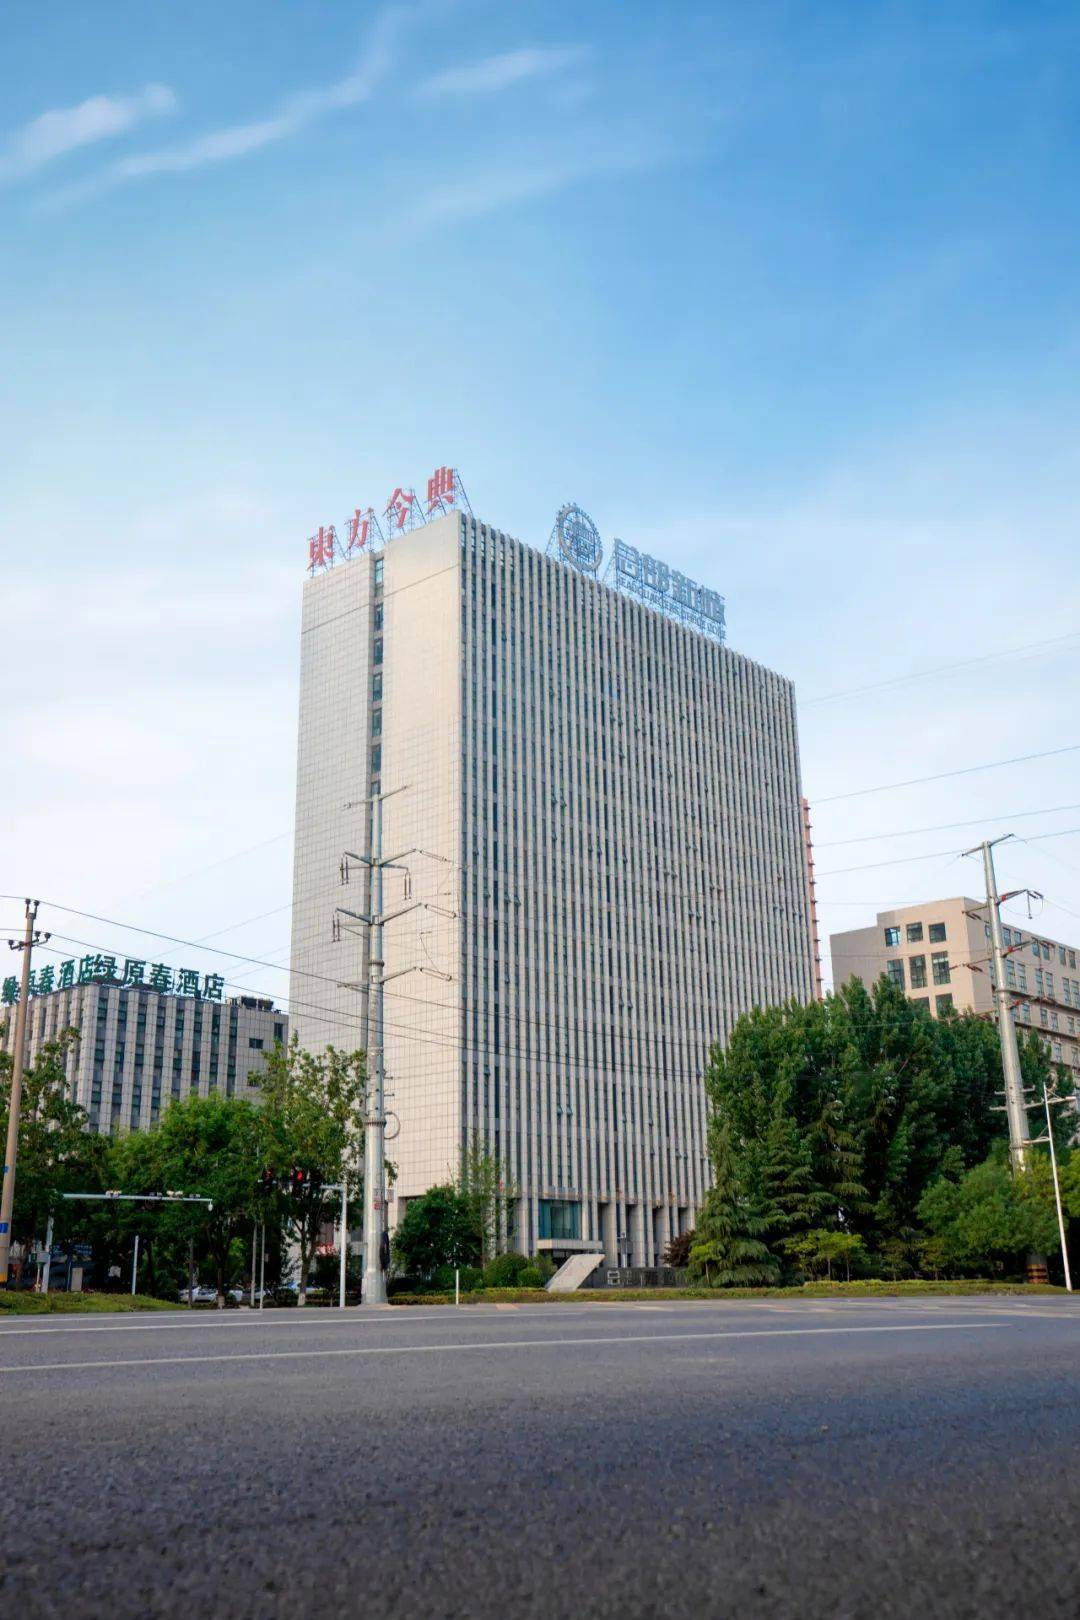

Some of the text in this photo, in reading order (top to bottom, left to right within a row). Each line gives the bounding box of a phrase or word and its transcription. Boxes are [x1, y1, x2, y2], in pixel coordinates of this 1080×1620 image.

[93, 953, 225, 1000] 绿原春酒店
